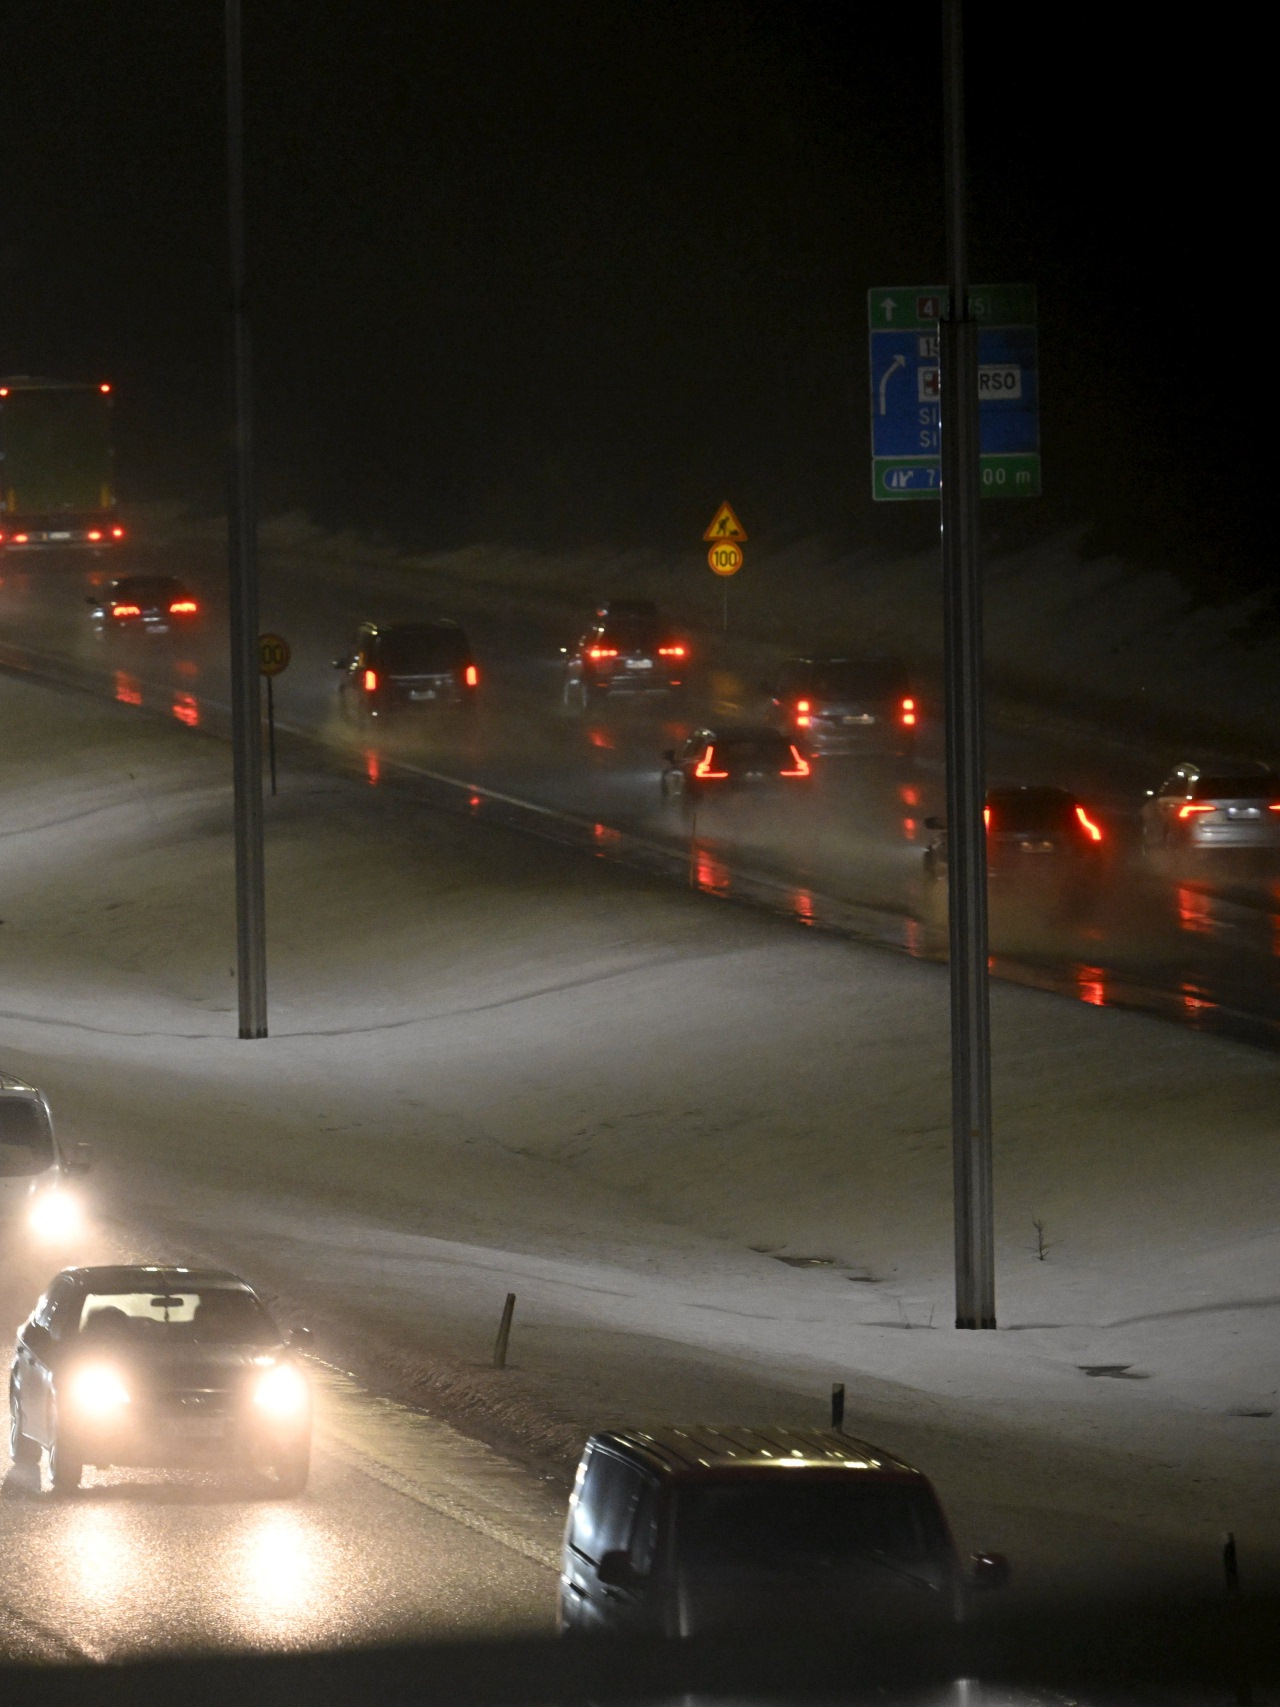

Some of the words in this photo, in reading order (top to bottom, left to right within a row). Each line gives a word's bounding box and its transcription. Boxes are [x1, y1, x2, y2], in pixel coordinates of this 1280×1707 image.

[923, 299, 933, 316] 4
[979, 372, 1016, 391] RSO
[982, 468, 1006, 484] 00
[1016, 470, 1031, 483] m
[714, 550, 737, 567] 100
[261, 644, 283, 664] 00
